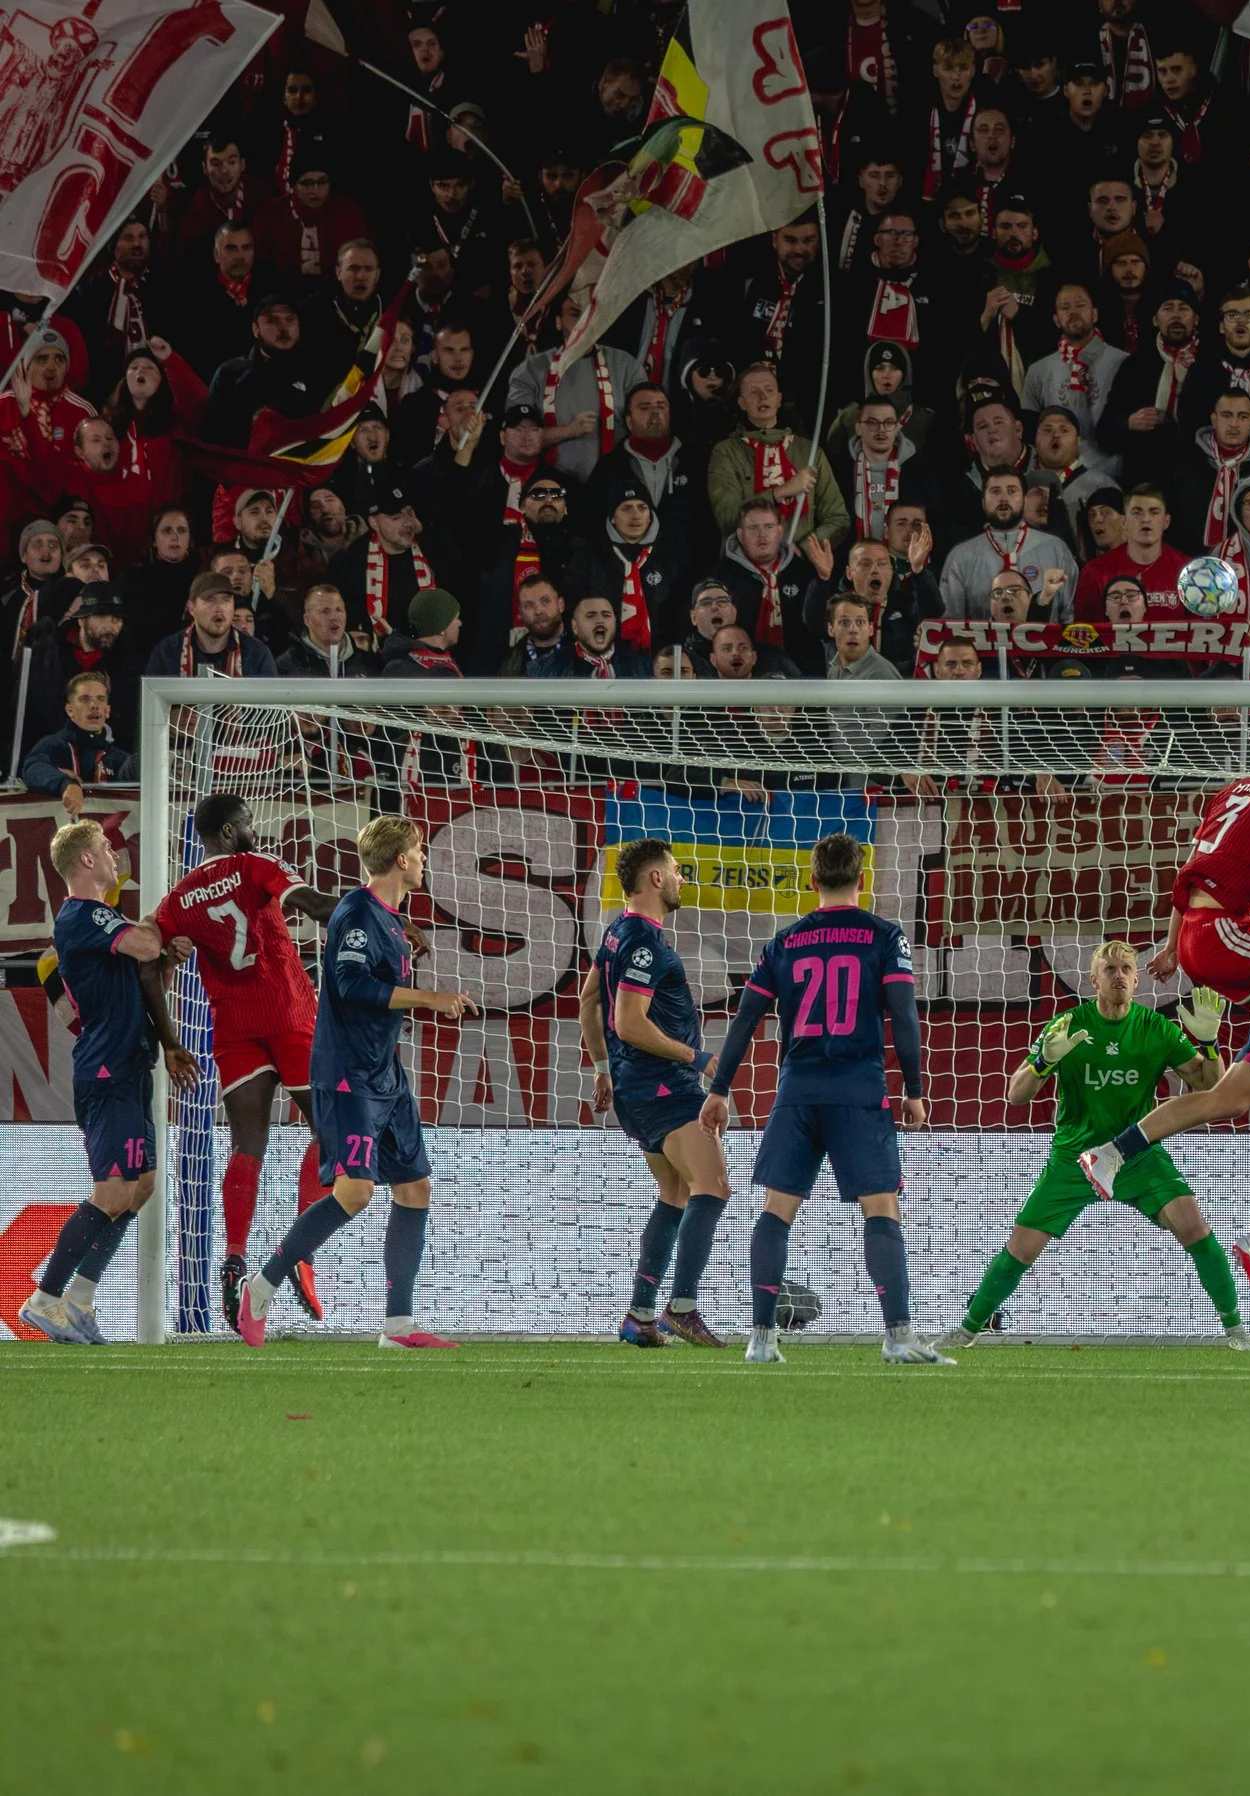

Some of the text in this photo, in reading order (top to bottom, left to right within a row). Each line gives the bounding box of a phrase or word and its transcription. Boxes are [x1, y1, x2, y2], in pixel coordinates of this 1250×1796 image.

[711, 865, 771, 889] ZEISS
[207, 899, 258, 971] 2
[784, 927, 875, 949] CHRISTIANSEN
[792, 954, 862, 1039] 20
[1084, 1063, 1140, 1091] Lyse
[346, 1134, 375, 1168] 27
